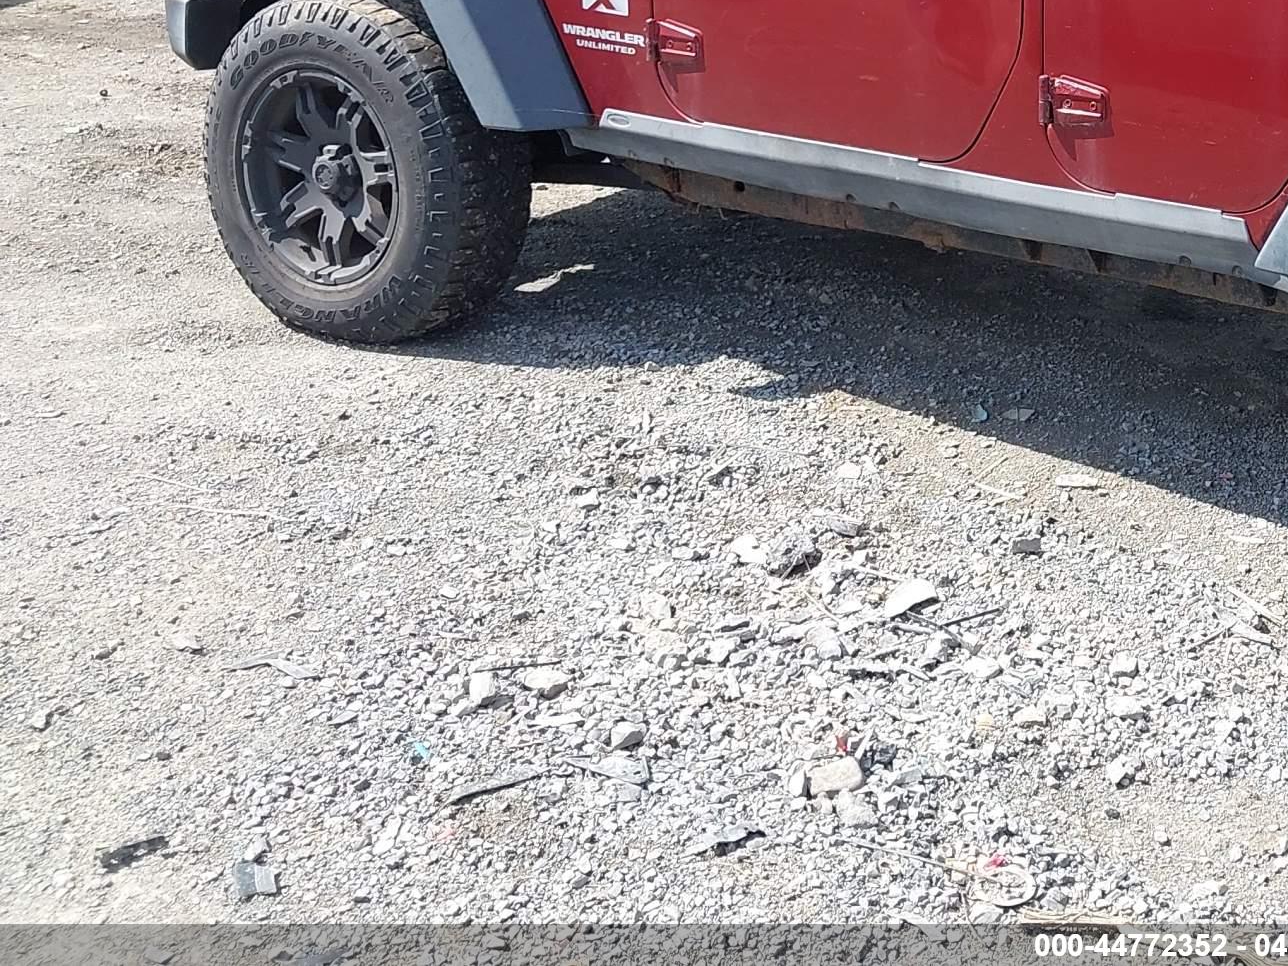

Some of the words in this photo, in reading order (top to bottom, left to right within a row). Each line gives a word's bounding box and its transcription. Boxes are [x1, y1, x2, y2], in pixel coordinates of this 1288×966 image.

[561, 23, 646, 47] WRANGLER
[575, 38, 637, 56] UNLIMITED
[229, 32, 395, 104] GOODYEAR
